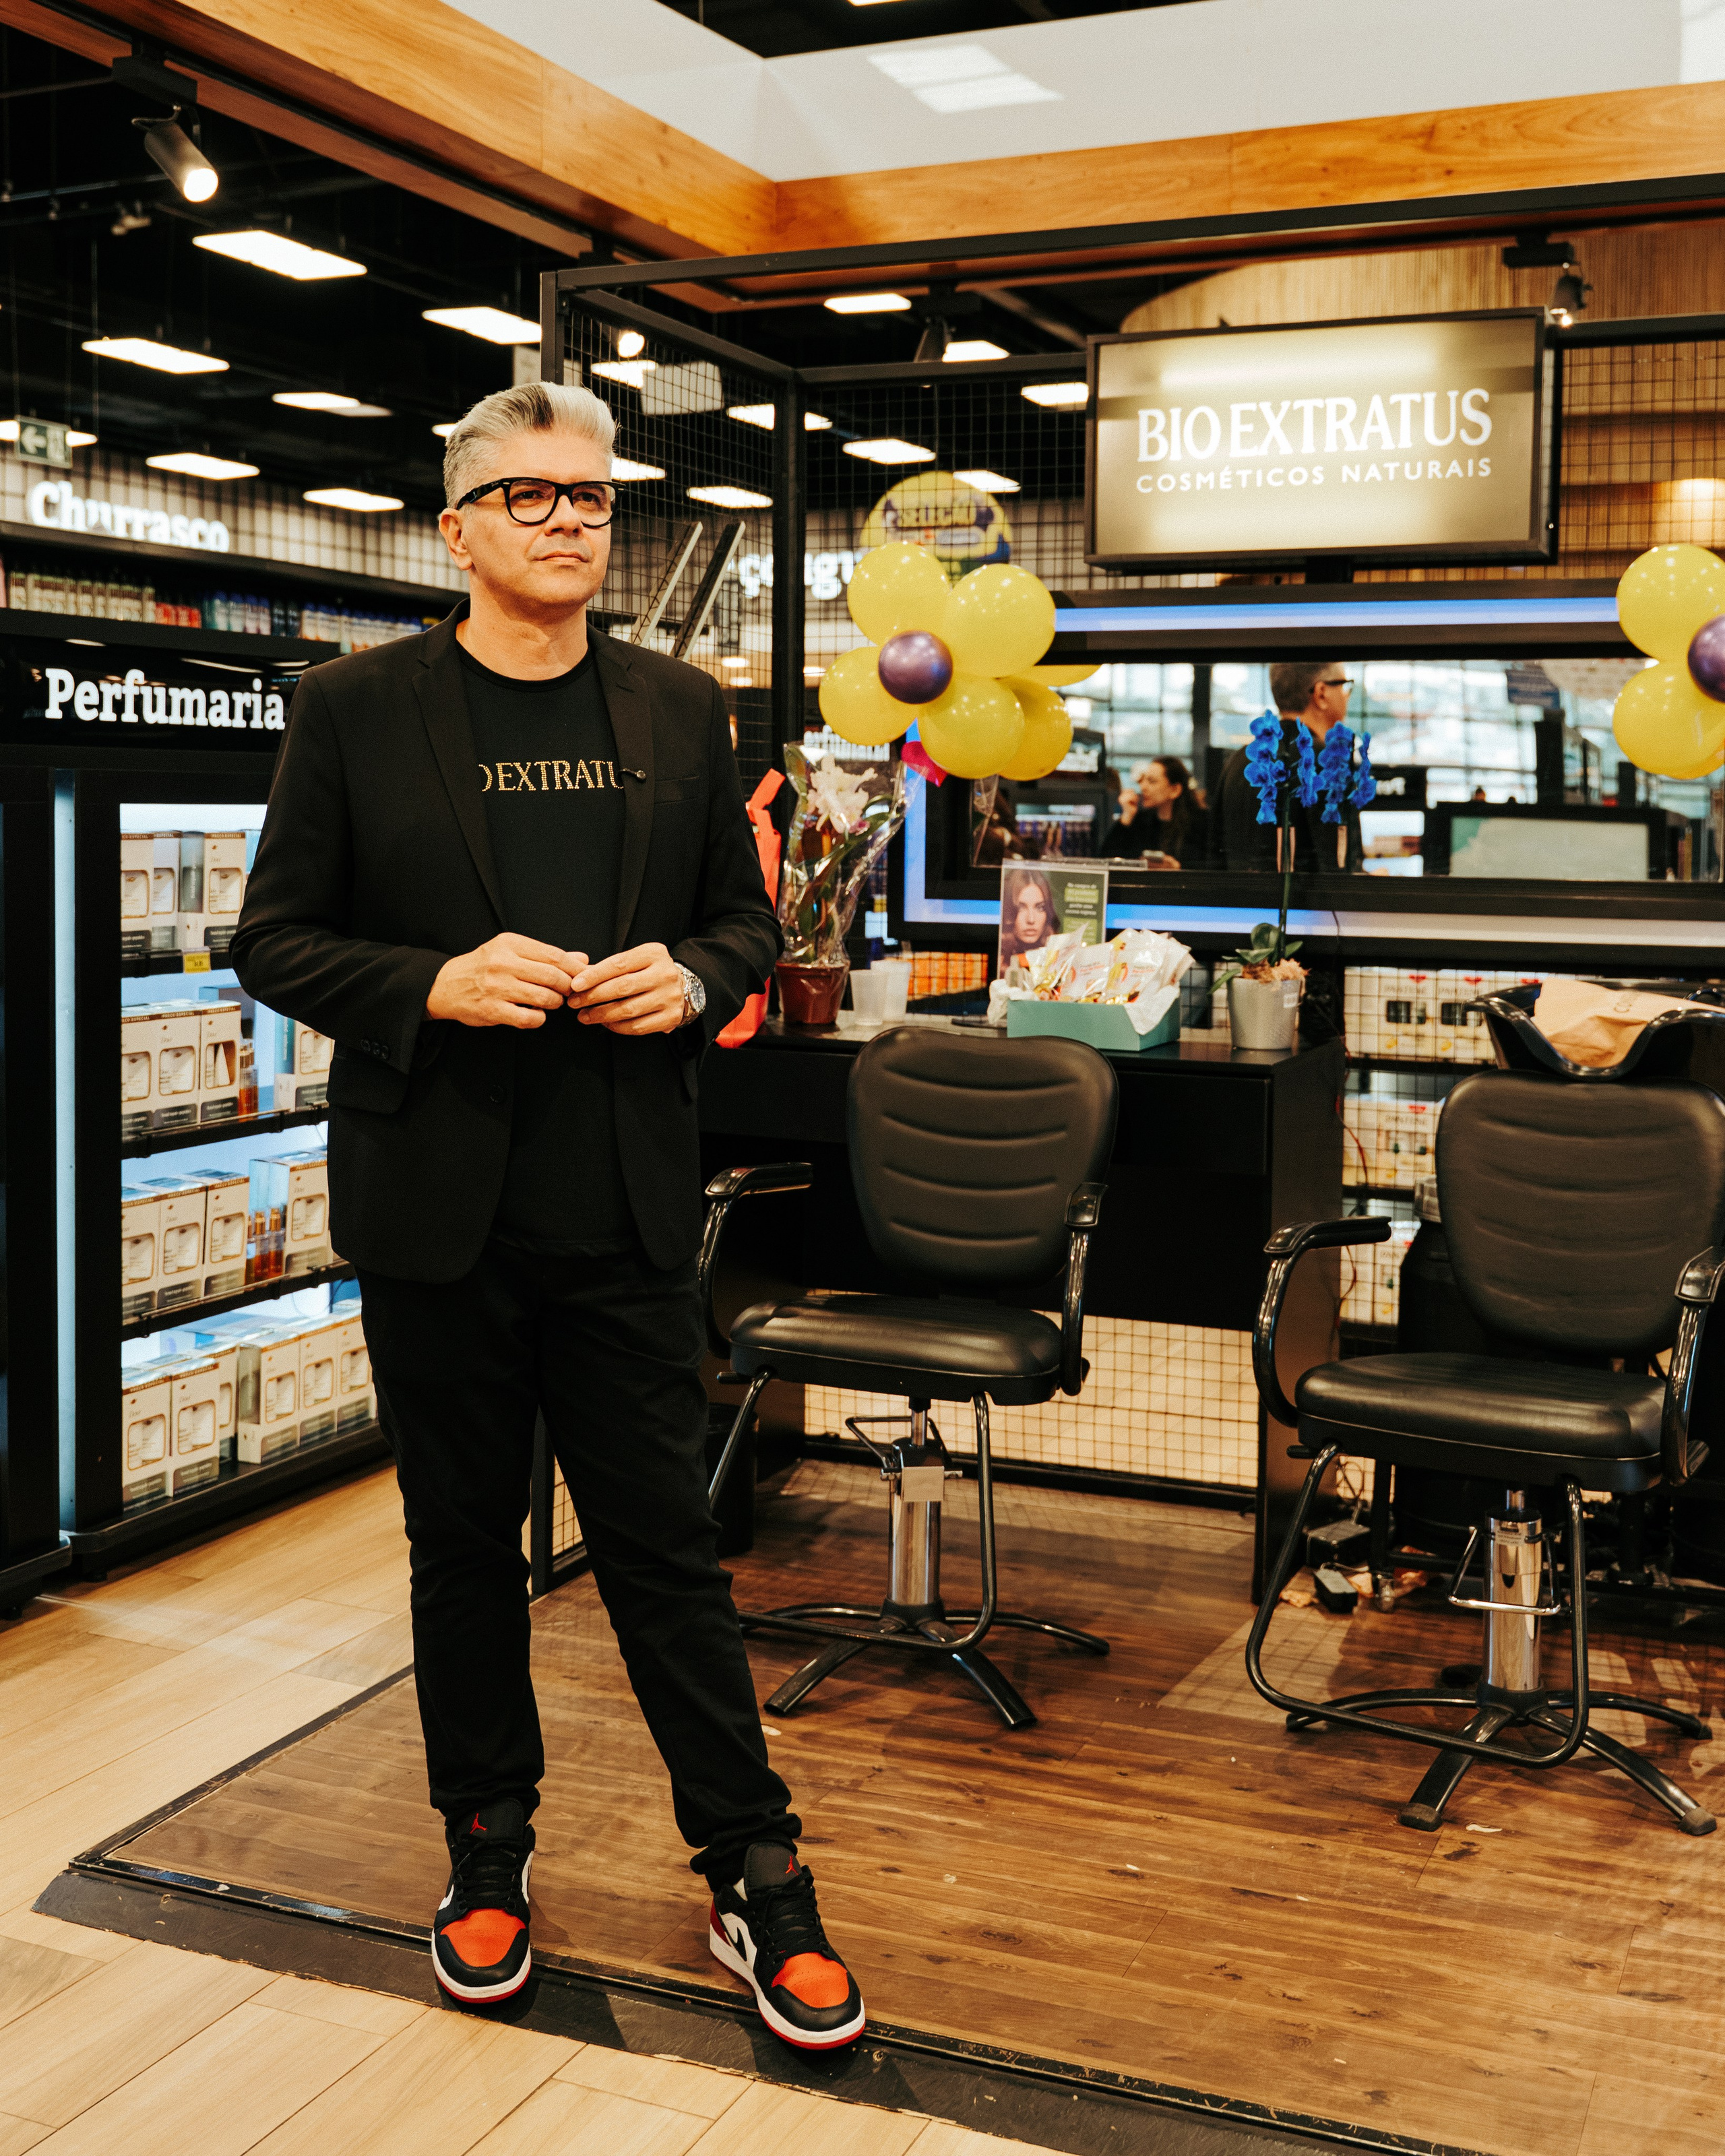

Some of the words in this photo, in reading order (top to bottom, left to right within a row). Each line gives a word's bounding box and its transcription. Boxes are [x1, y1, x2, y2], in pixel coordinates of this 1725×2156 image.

[1137, 404, 1222, 462] BIO
[1229, 388, 1493, 458] EXTRATUS
[1136, 465, 1325, 493] COSMÉTICOS
[1342, 457, 1491, 483] NATURAIS
[30, 480, 230, 552] Churrasco
[44, 668, 286, 730] Perfumaria
[495, 759, 624, 792] EXTRATU
